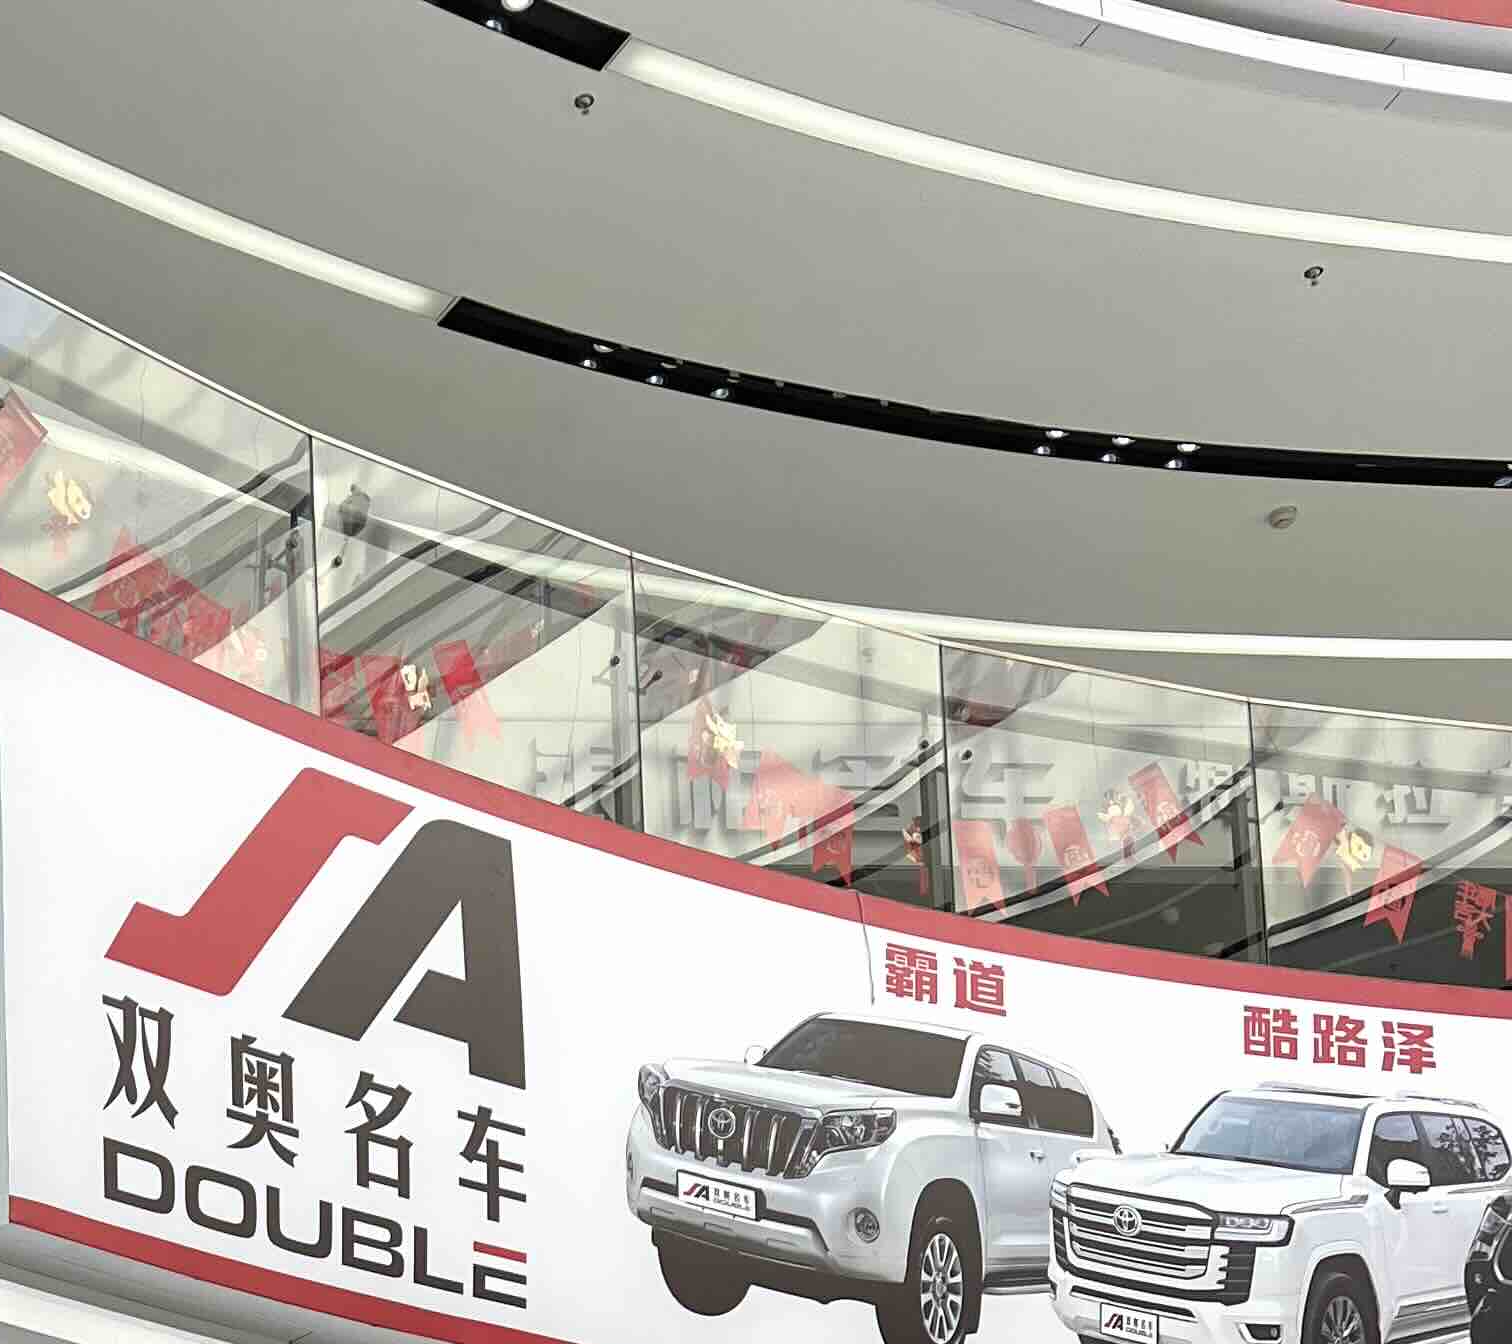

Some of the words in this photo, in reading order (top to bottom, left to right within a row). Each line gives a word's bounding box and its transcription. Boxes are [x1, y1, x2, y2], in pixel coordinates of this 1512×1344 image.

[885, 942, 1007, 1017] 霸道
[1243, 1005, 1437, 1075] 酷路泽
[101, 994, 528, 1222] 双奥名车
[102, 1135, 528, 1310] DOUBLE
